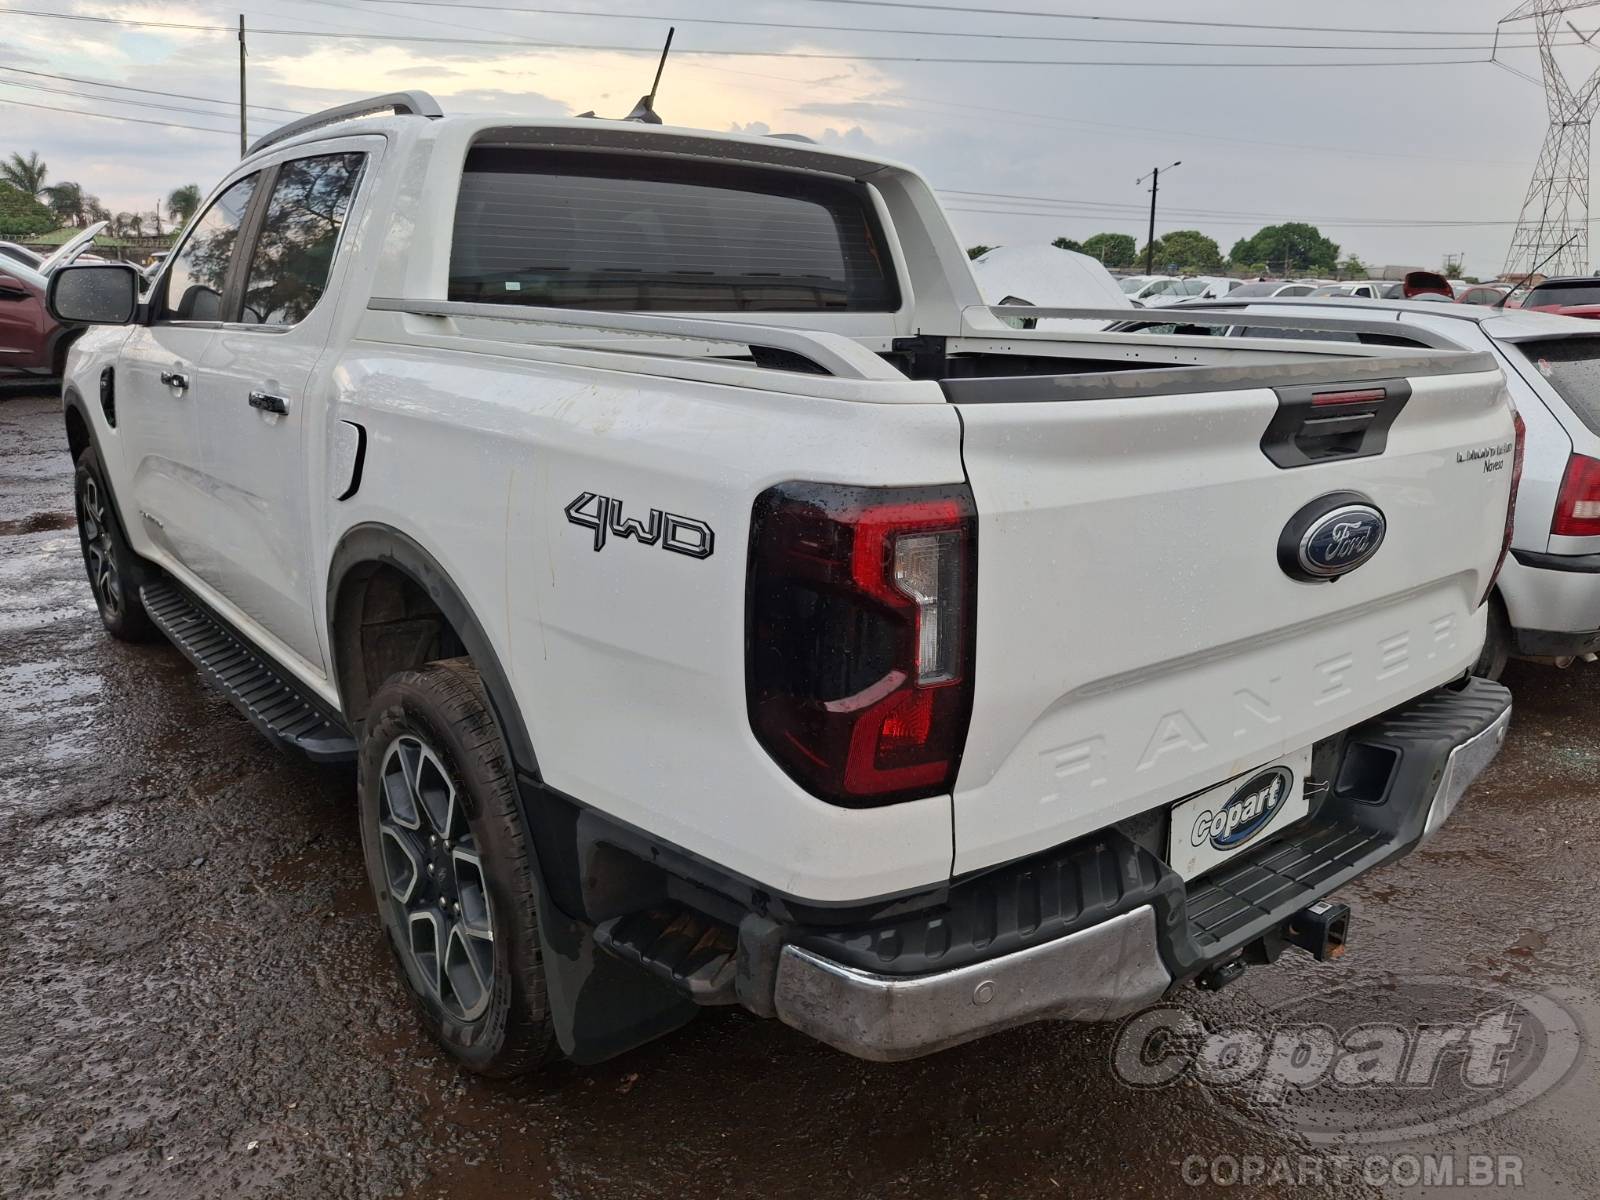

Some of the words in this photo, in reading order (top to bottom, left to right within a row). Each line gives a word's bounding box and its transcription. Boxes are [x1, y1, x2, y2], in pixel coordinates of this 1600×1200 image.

[564, 491, 715, 560] 4WD
[1325, 522, 1371, 561] Ford
[1039, 612, 1456, 803] RANGER
[1190, 772, 1281, 847] Copart
